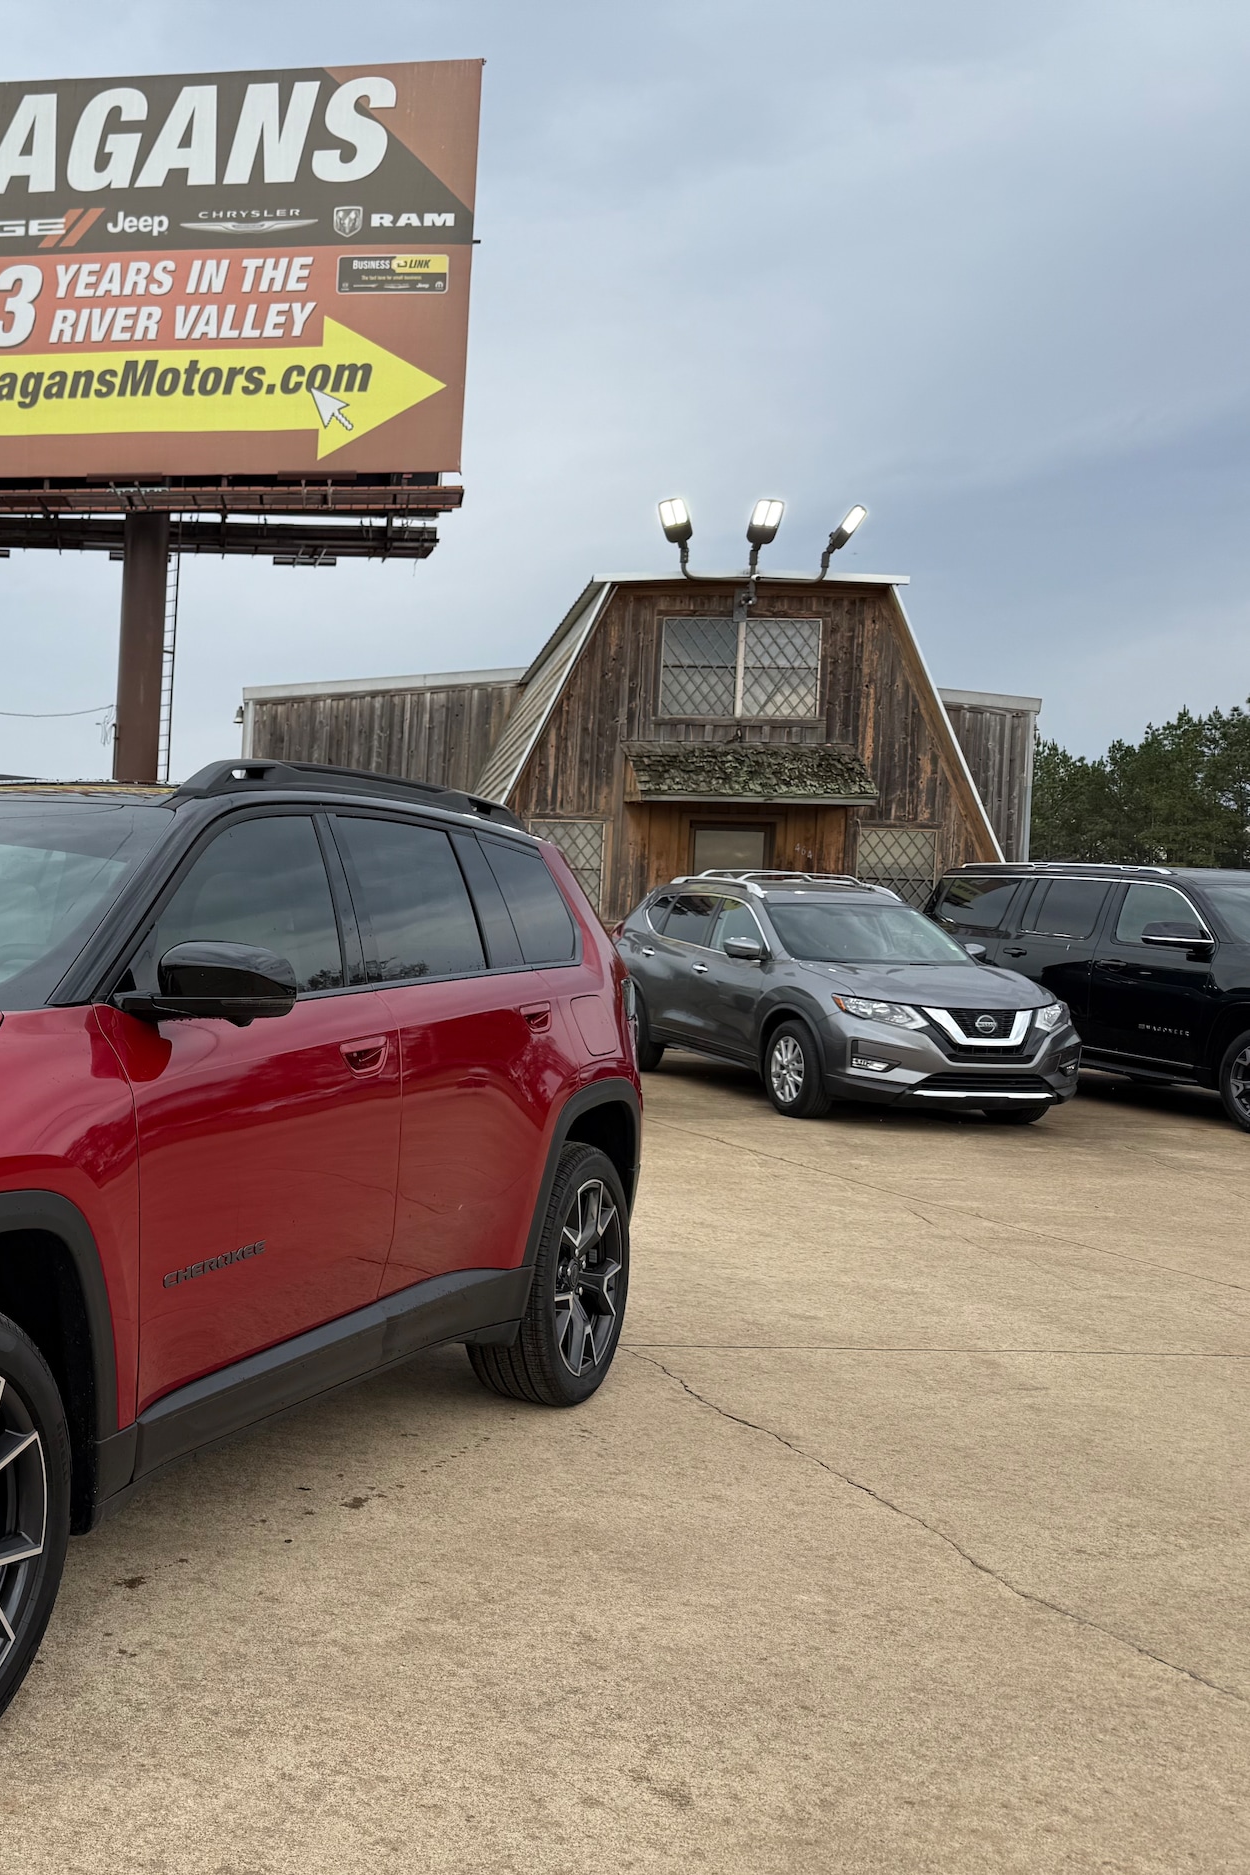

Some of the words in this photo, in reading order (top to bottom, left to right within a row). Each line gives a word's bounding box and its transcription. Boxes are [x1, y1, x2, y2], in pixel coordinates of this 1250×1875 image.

[107, 211, 169, 236] Jeep
[198, 208, 301, 219] CHRYSLER
[370, 213, 455, 227] RAM
[409, 259, 431, 269] LINK
[55, 260, 176, 298] YEARS
[185, 259, 230, 294] IN
[241, 256, 314, 293] THE
[48, 305, 162, 344] RIVER
[174, 301, 317, 340] VALLEY
[162, 1239, 266, 1289] CHEROKEE
